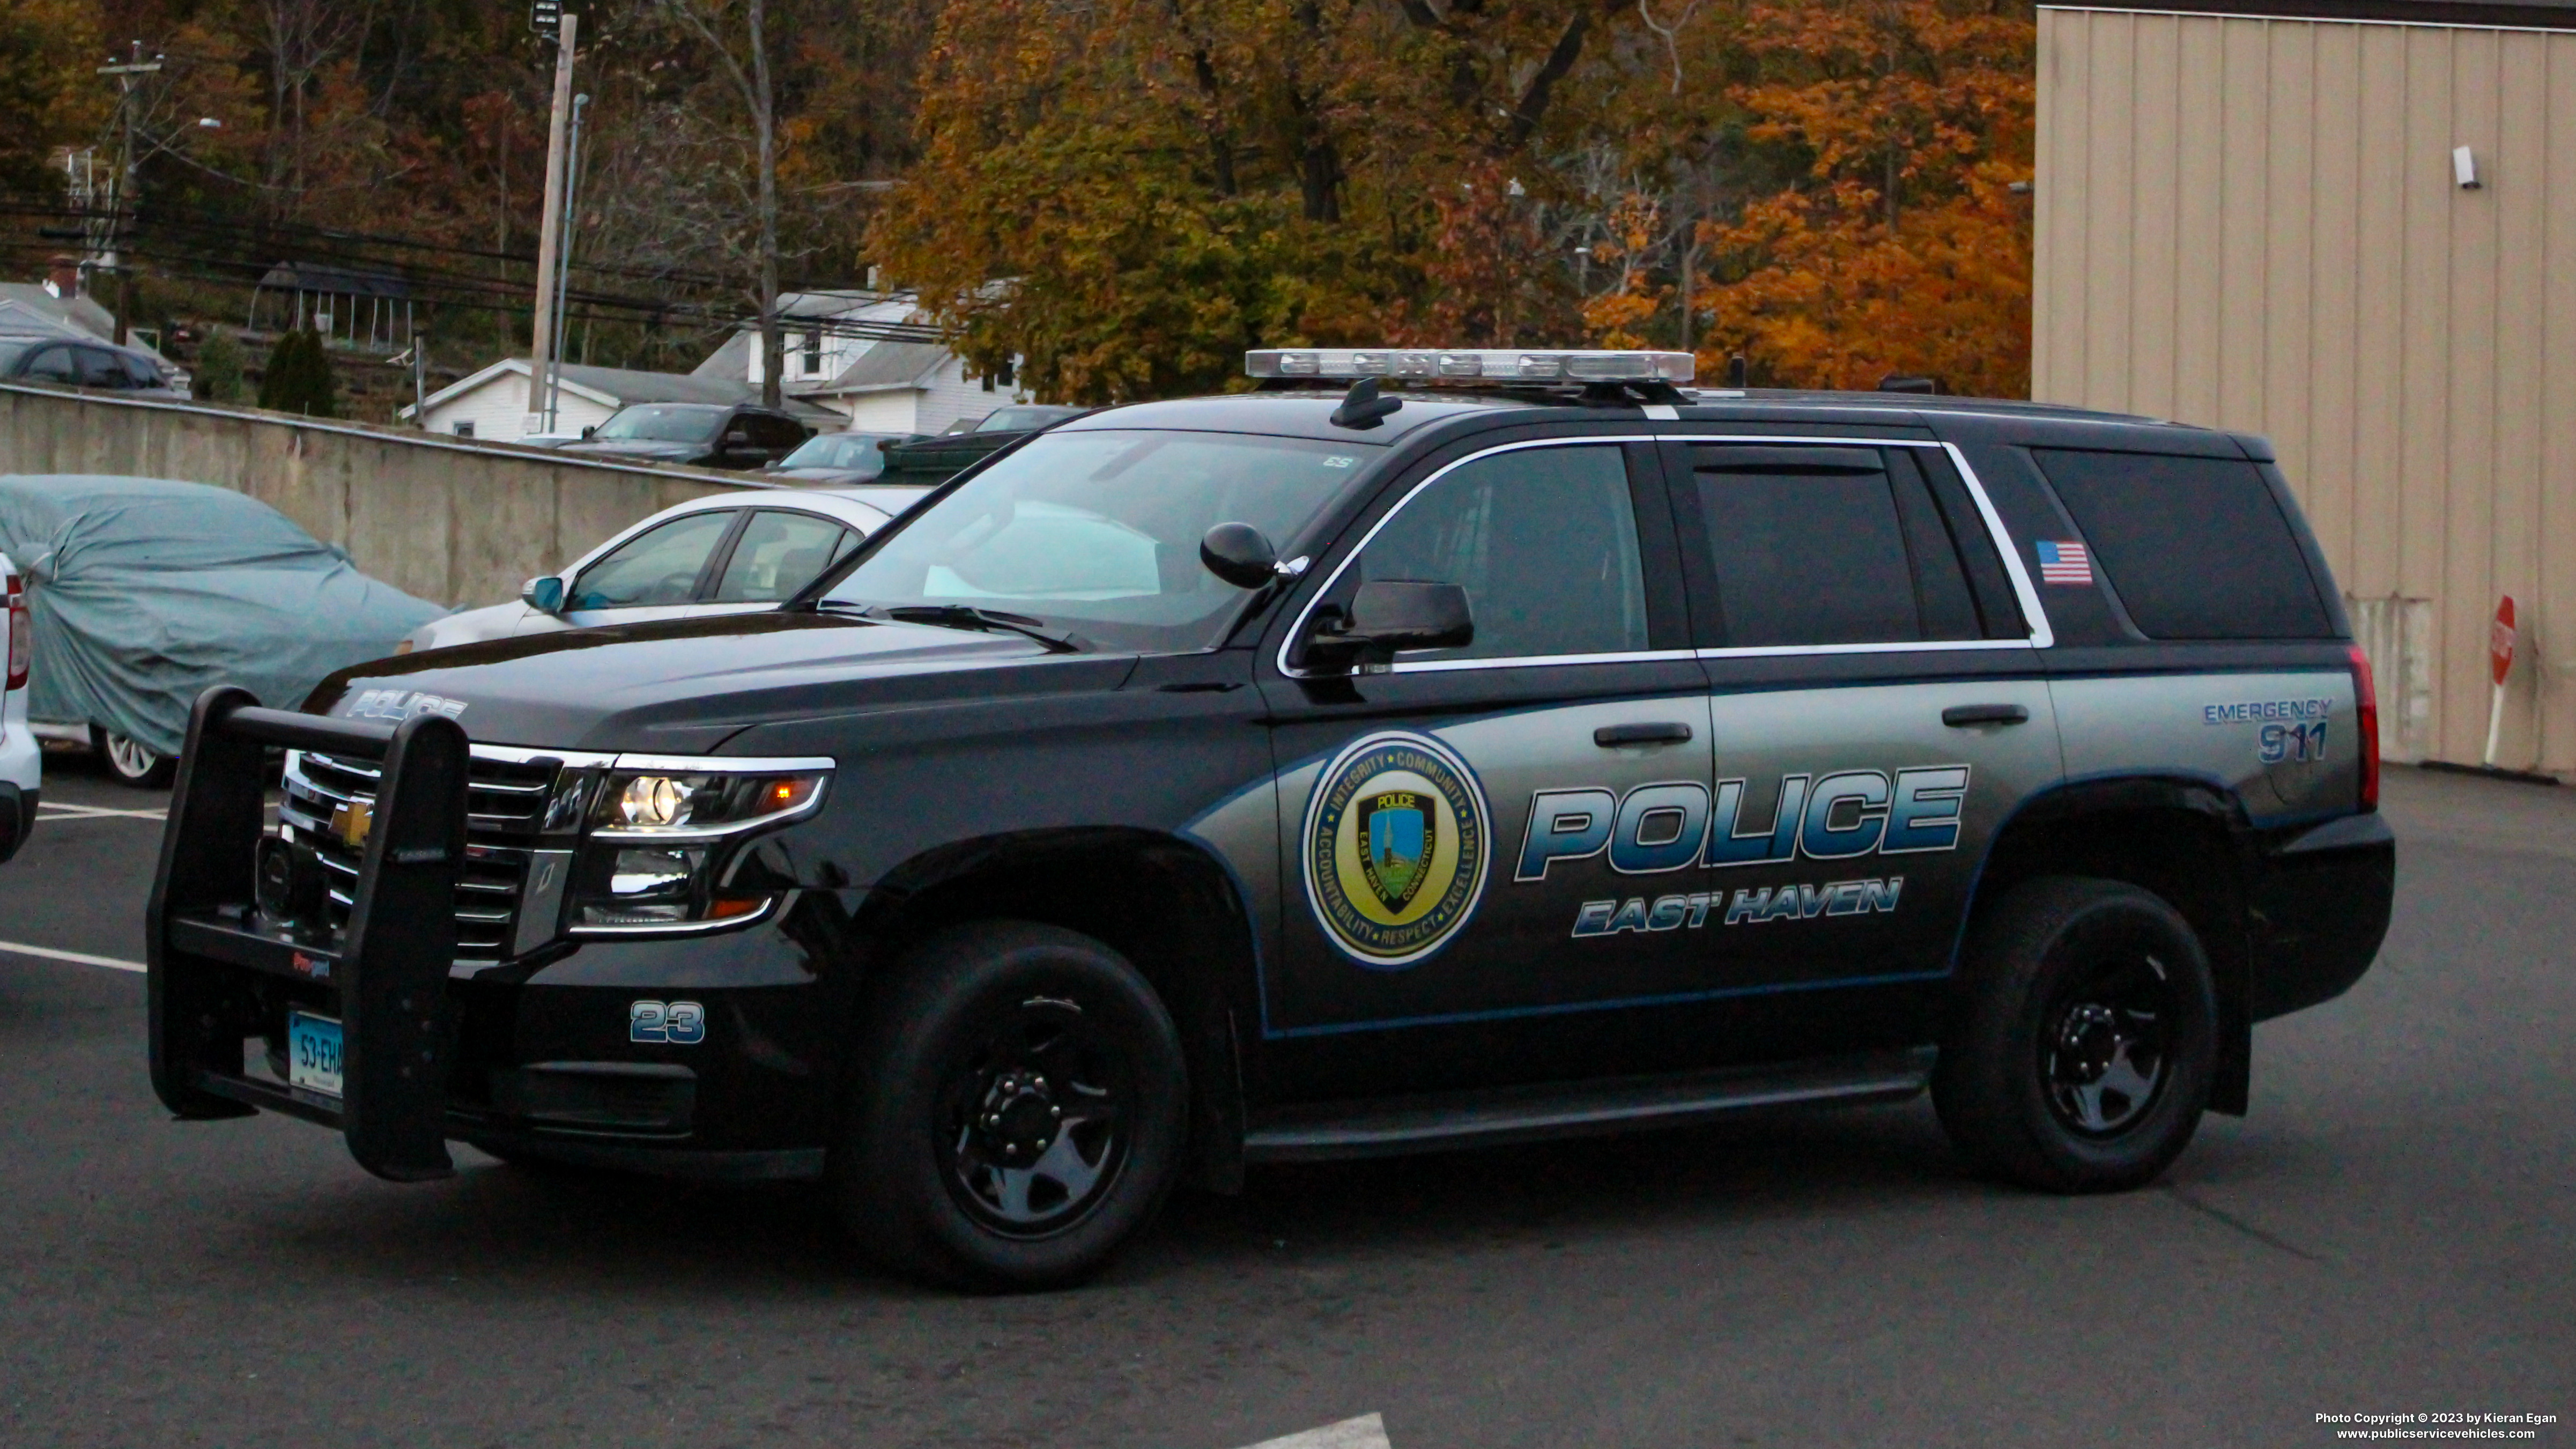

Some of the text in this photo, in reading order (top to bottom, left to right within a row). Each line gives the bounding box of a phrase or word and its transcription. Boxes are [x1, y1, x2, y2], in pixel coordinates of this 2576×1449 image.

[346, 689, 469, 721] POLICE
[2204, 697, 2334, 722] EMERGENCY
[2258, 721, 2328, 764] 911
[1329, 753, 1385, 811] INTEGRITY
[1377, 793, 1416, 809] POLICE
[1397, 751, 1467, 808] COMMUNITY
[1514, 764, 1972, 882] POLICE
[1319, 826, 1374, 938] ACCOUNTABILITY
[1360, 831, 1390, 902] EAST HAVEN
[1441, 818, 1475, 915] EXCELLENCE
[1381, 914, 1437, 945] RESPECT
[1571, 876, 1904, 937] EAST HAVEN
[631, 1000, 705, 1044] 23
